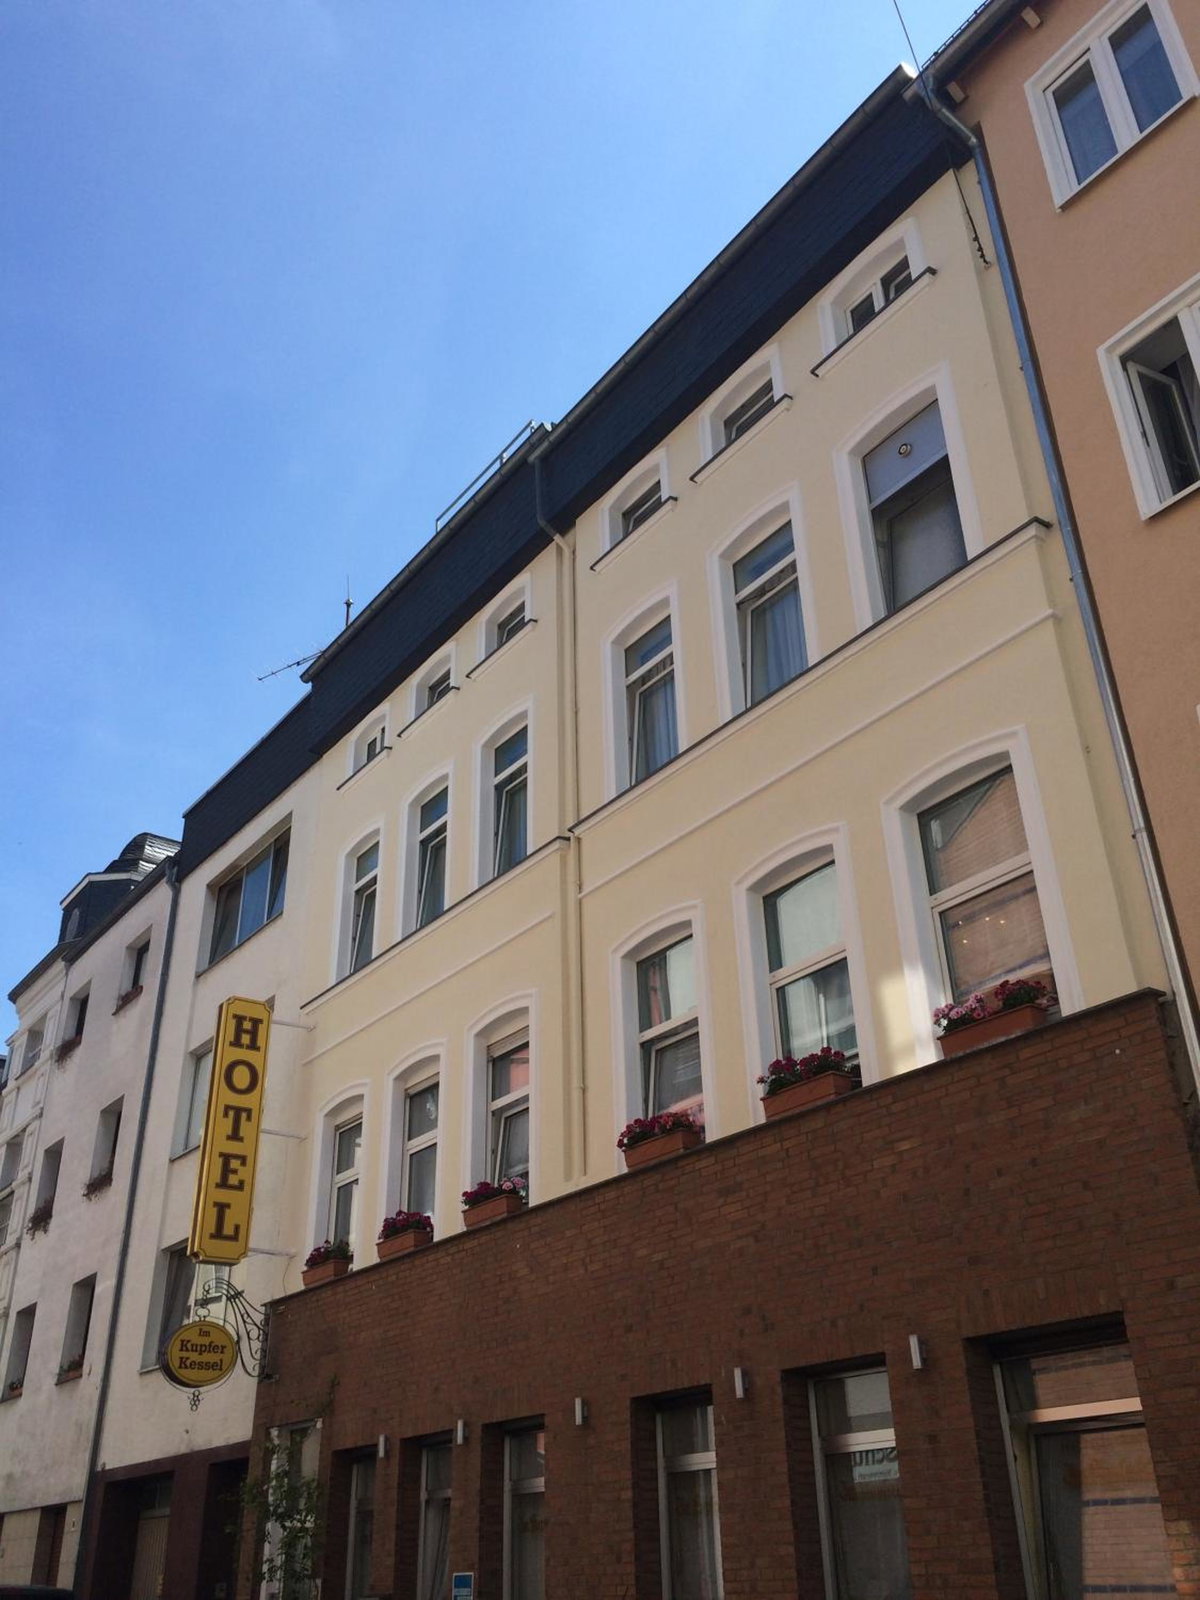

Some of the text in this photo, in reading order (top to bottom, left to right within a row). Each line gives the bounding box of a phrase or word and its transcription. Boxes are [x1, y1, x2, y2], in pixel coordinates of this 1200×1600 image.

[209, 1013, 264, 1242] HOTEL
[198, 1328, 211, 1337] Im
[179, 1339, 227, 1355] Kupfer
[178, 1357, 223, 1371] Kessel
